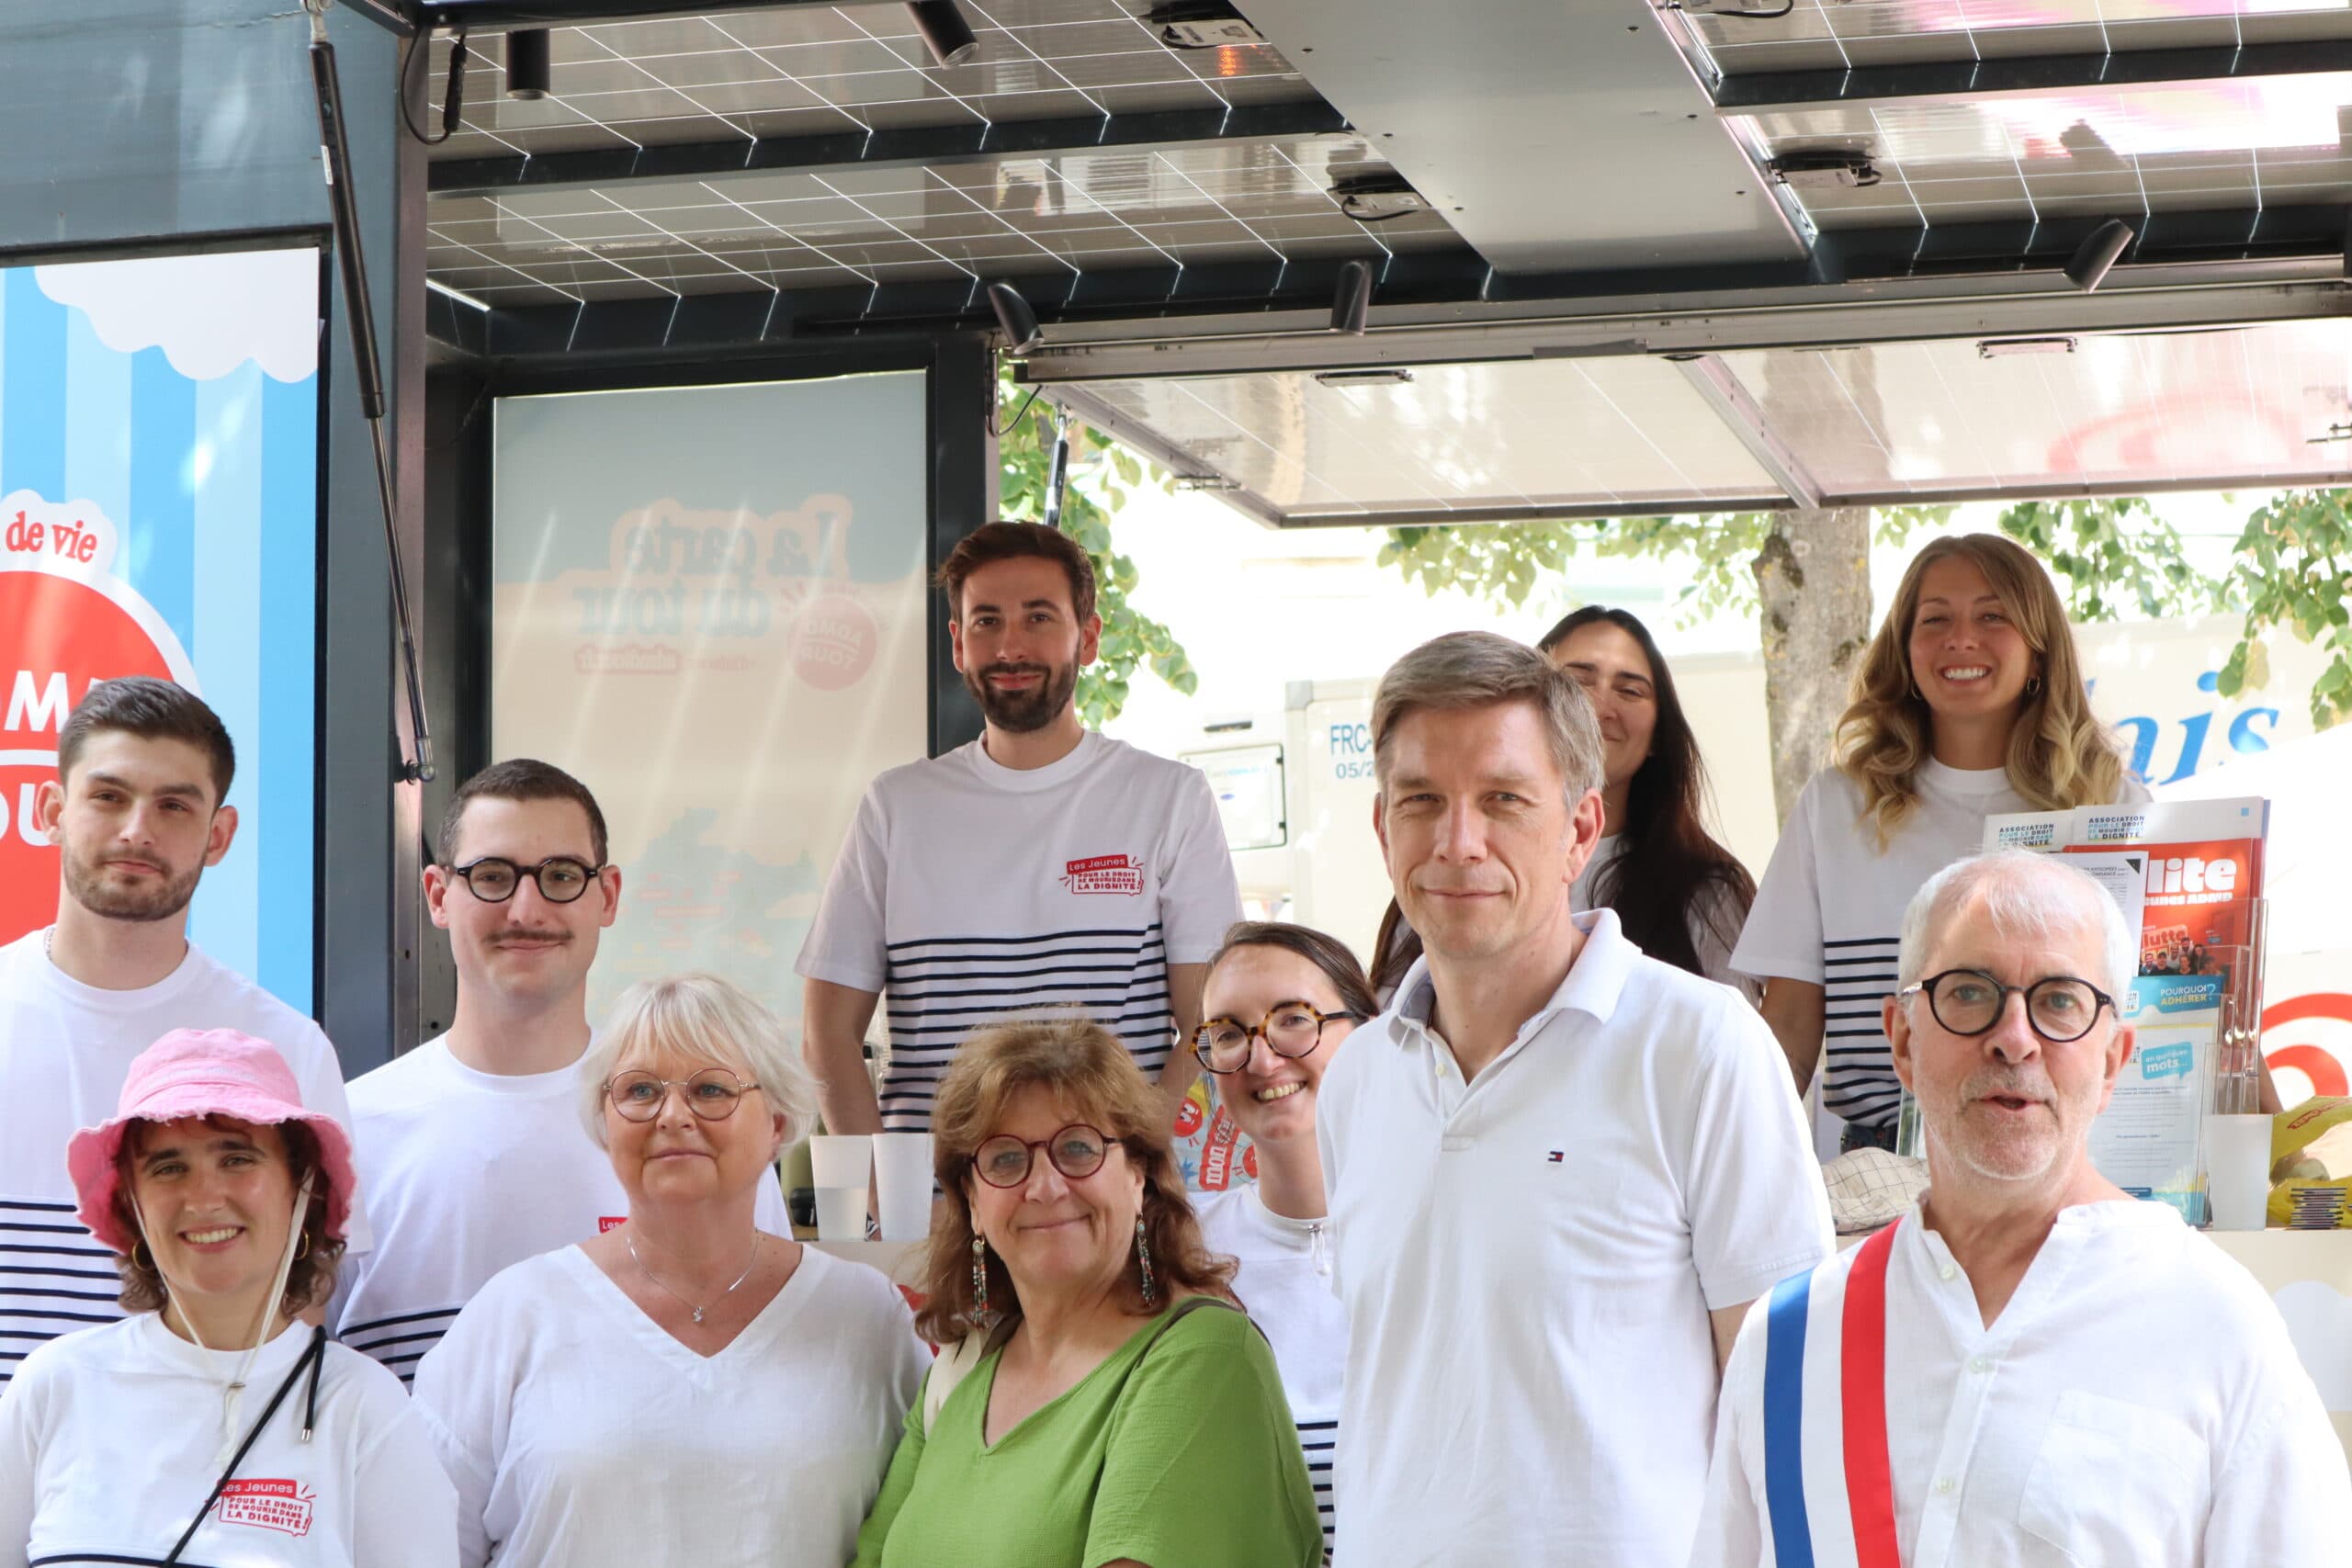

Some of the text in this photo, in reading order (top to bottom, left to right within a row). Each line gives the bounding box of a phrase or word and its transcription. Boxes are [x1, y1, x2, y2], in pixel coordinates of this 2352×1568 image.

[6, 512, 98, 563] de vie
[1336, 761, 1375, 780] 05/2
[1999, 823, 2054, 832] ASSOCIATION
[1069, 858, 1125, 871] Les Jeunes
[2147, 858, 2237, 893] lite
[2161, 985, 2207, 996] POURQUOI
[244, 1483, 293, 1494] Jeunes
[229, 1496, 256, 1505] POUR
[274, 1499, 304, 1512] DROIT
[243, 1505, 277, 1514] MOURIR
[279, 1509, 302, 1519] DANS
